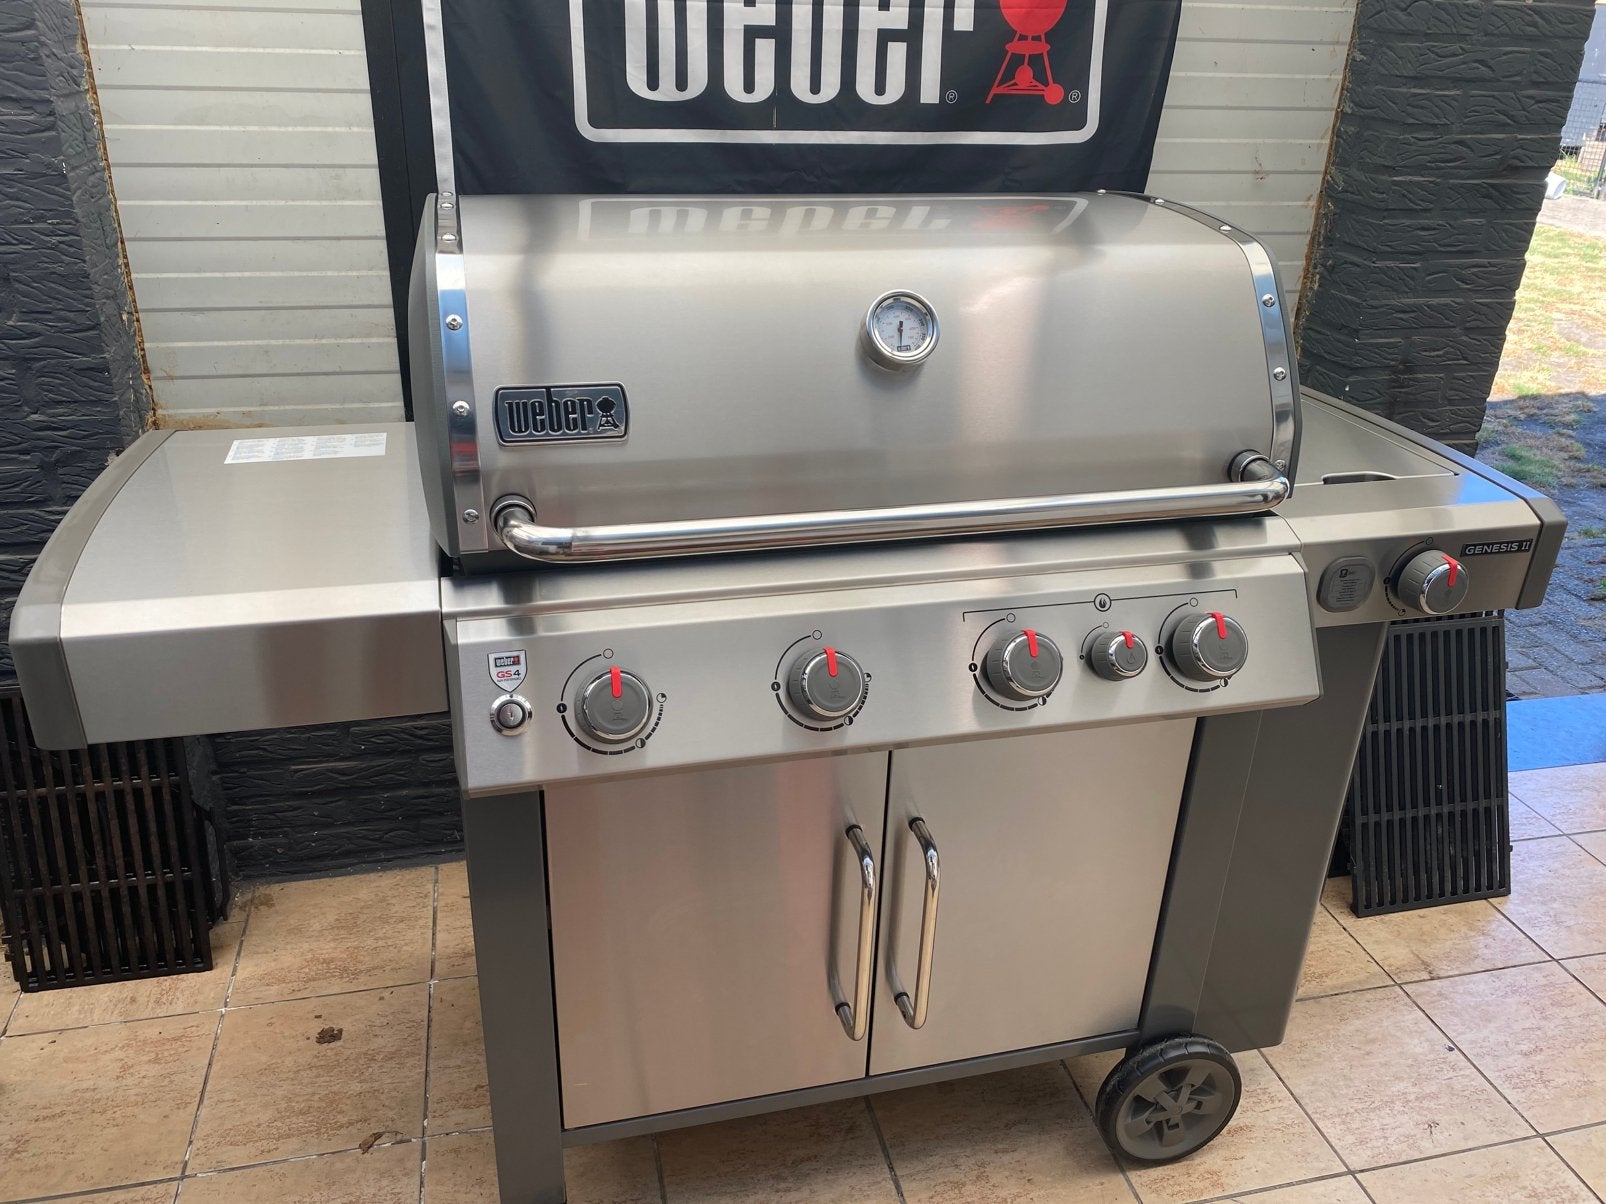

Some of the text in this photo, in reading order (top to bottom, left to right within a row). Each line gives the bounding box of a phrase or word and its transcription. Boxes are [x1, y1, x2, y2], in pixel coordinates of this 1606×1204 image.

[505, 387, 594, 435] weber
[1465, 541, 1530, 555] GENESIS II
[496, 669, 521, 679] GS4
